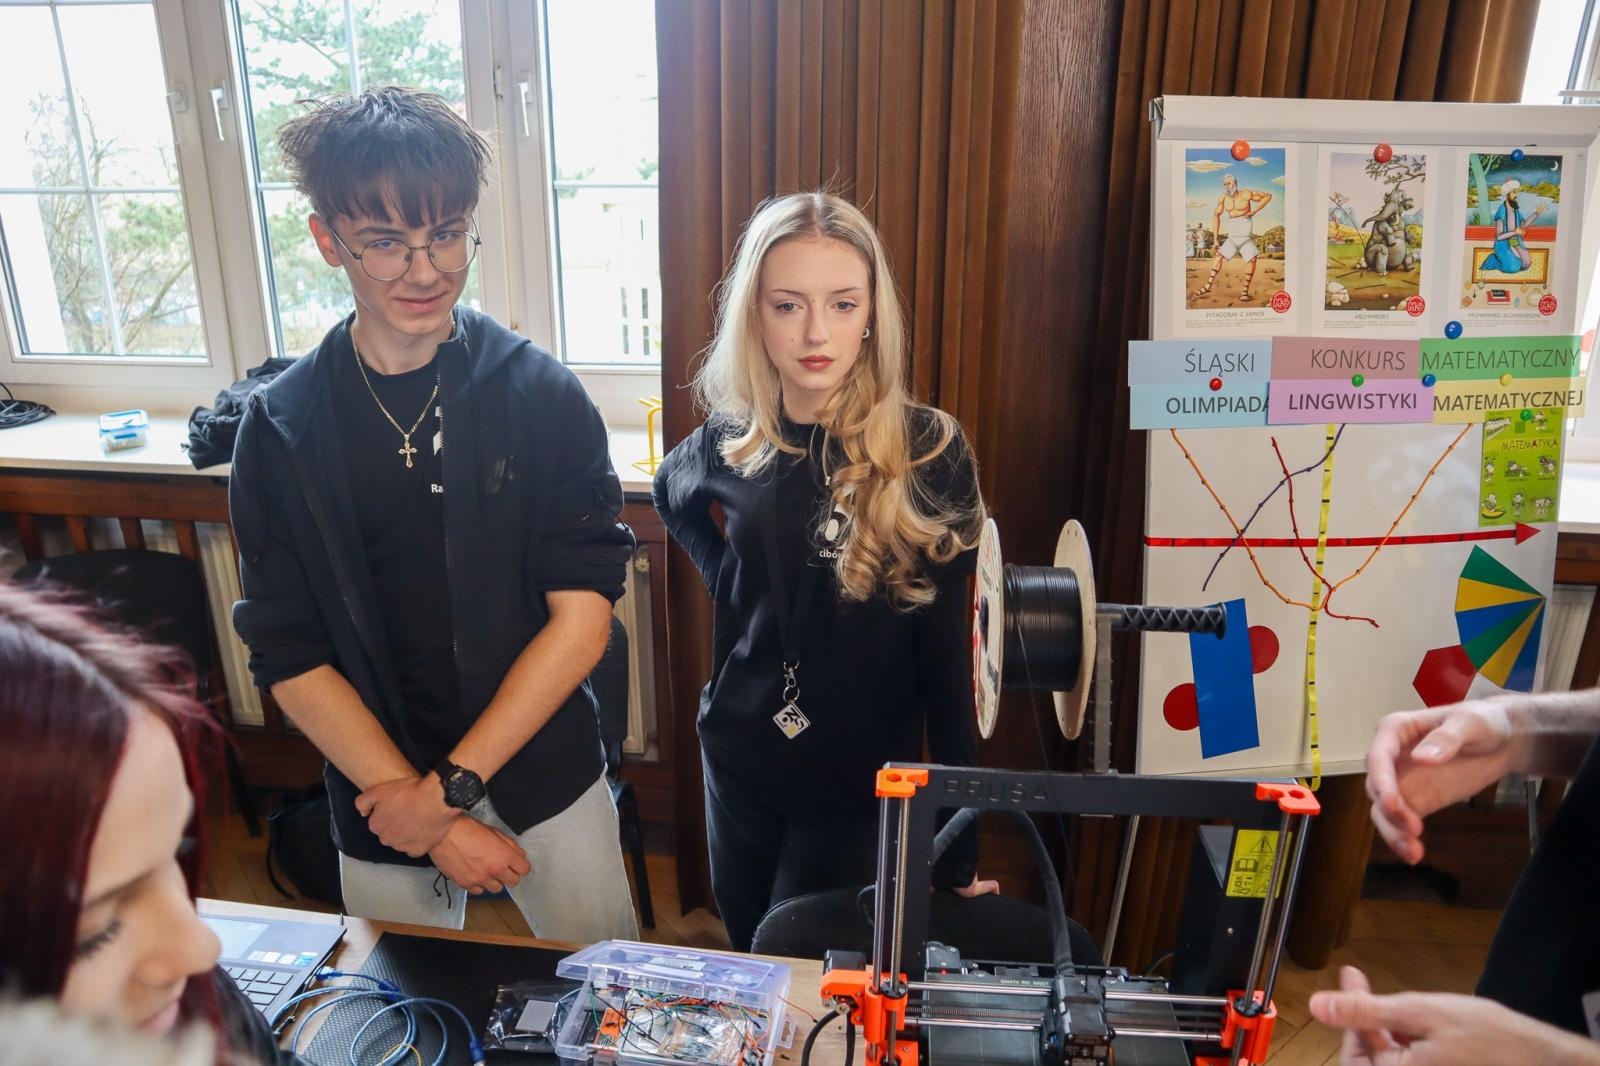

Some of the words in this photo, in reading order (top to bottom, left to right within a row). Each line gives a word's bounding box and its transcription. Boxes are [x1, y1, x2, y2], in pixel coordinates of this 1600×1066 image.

[1184, 348, 1255, 378] ŚLĄSKI
[1310, 348, 1406, 371] KONKURS
[1421, 347, 1581, 371] MATEMATYCZNY
[1288, 392, 1417, 411] LINGWISTYKI
[1432, 389, 1584, 412] MATEMATYCZNEJ
[1502, 438, 1559, 450] MATEMATYKA
[945, 780, 1048, 804] PRUSA
